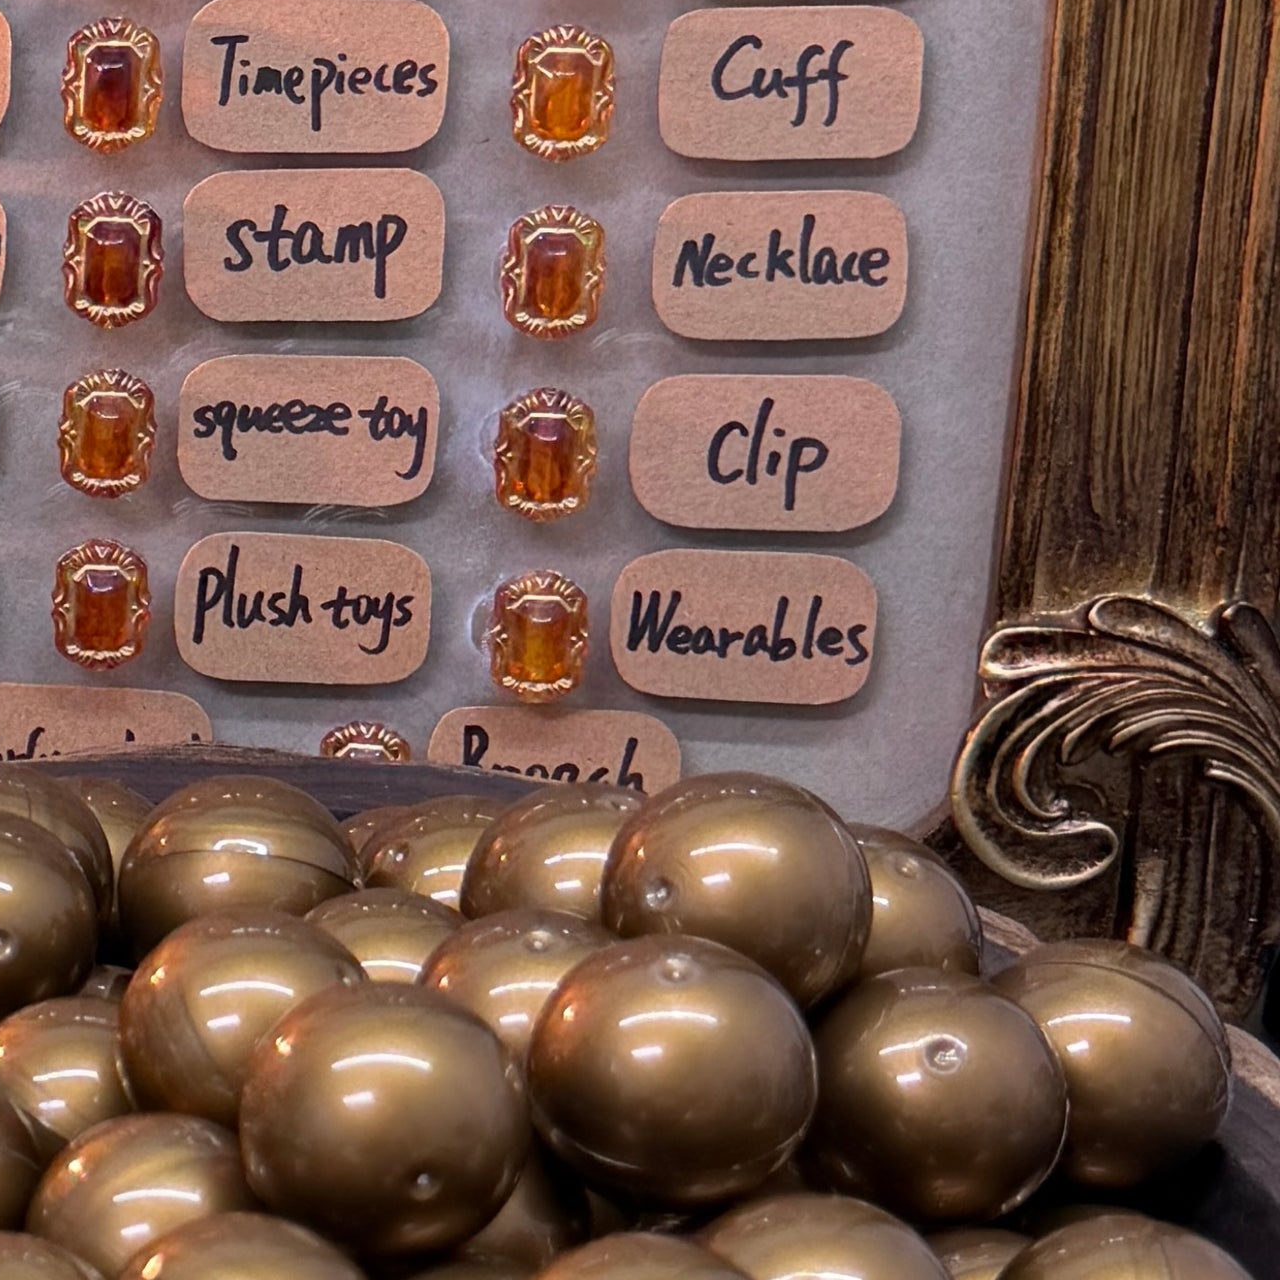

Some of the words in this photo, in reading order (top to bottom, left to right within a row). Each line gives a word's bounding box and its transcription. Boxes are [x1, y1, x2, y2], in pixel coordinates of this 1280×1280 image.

[211, 35, 437, 129] Timepieces
[712, 35, 854, 127] Cuff
[673, 210, 890, 287] Necklace
[358, 396, 427, 480] toy
[321, 587, 413, 654] toys
[627, 591, 868, 665] Wearables
